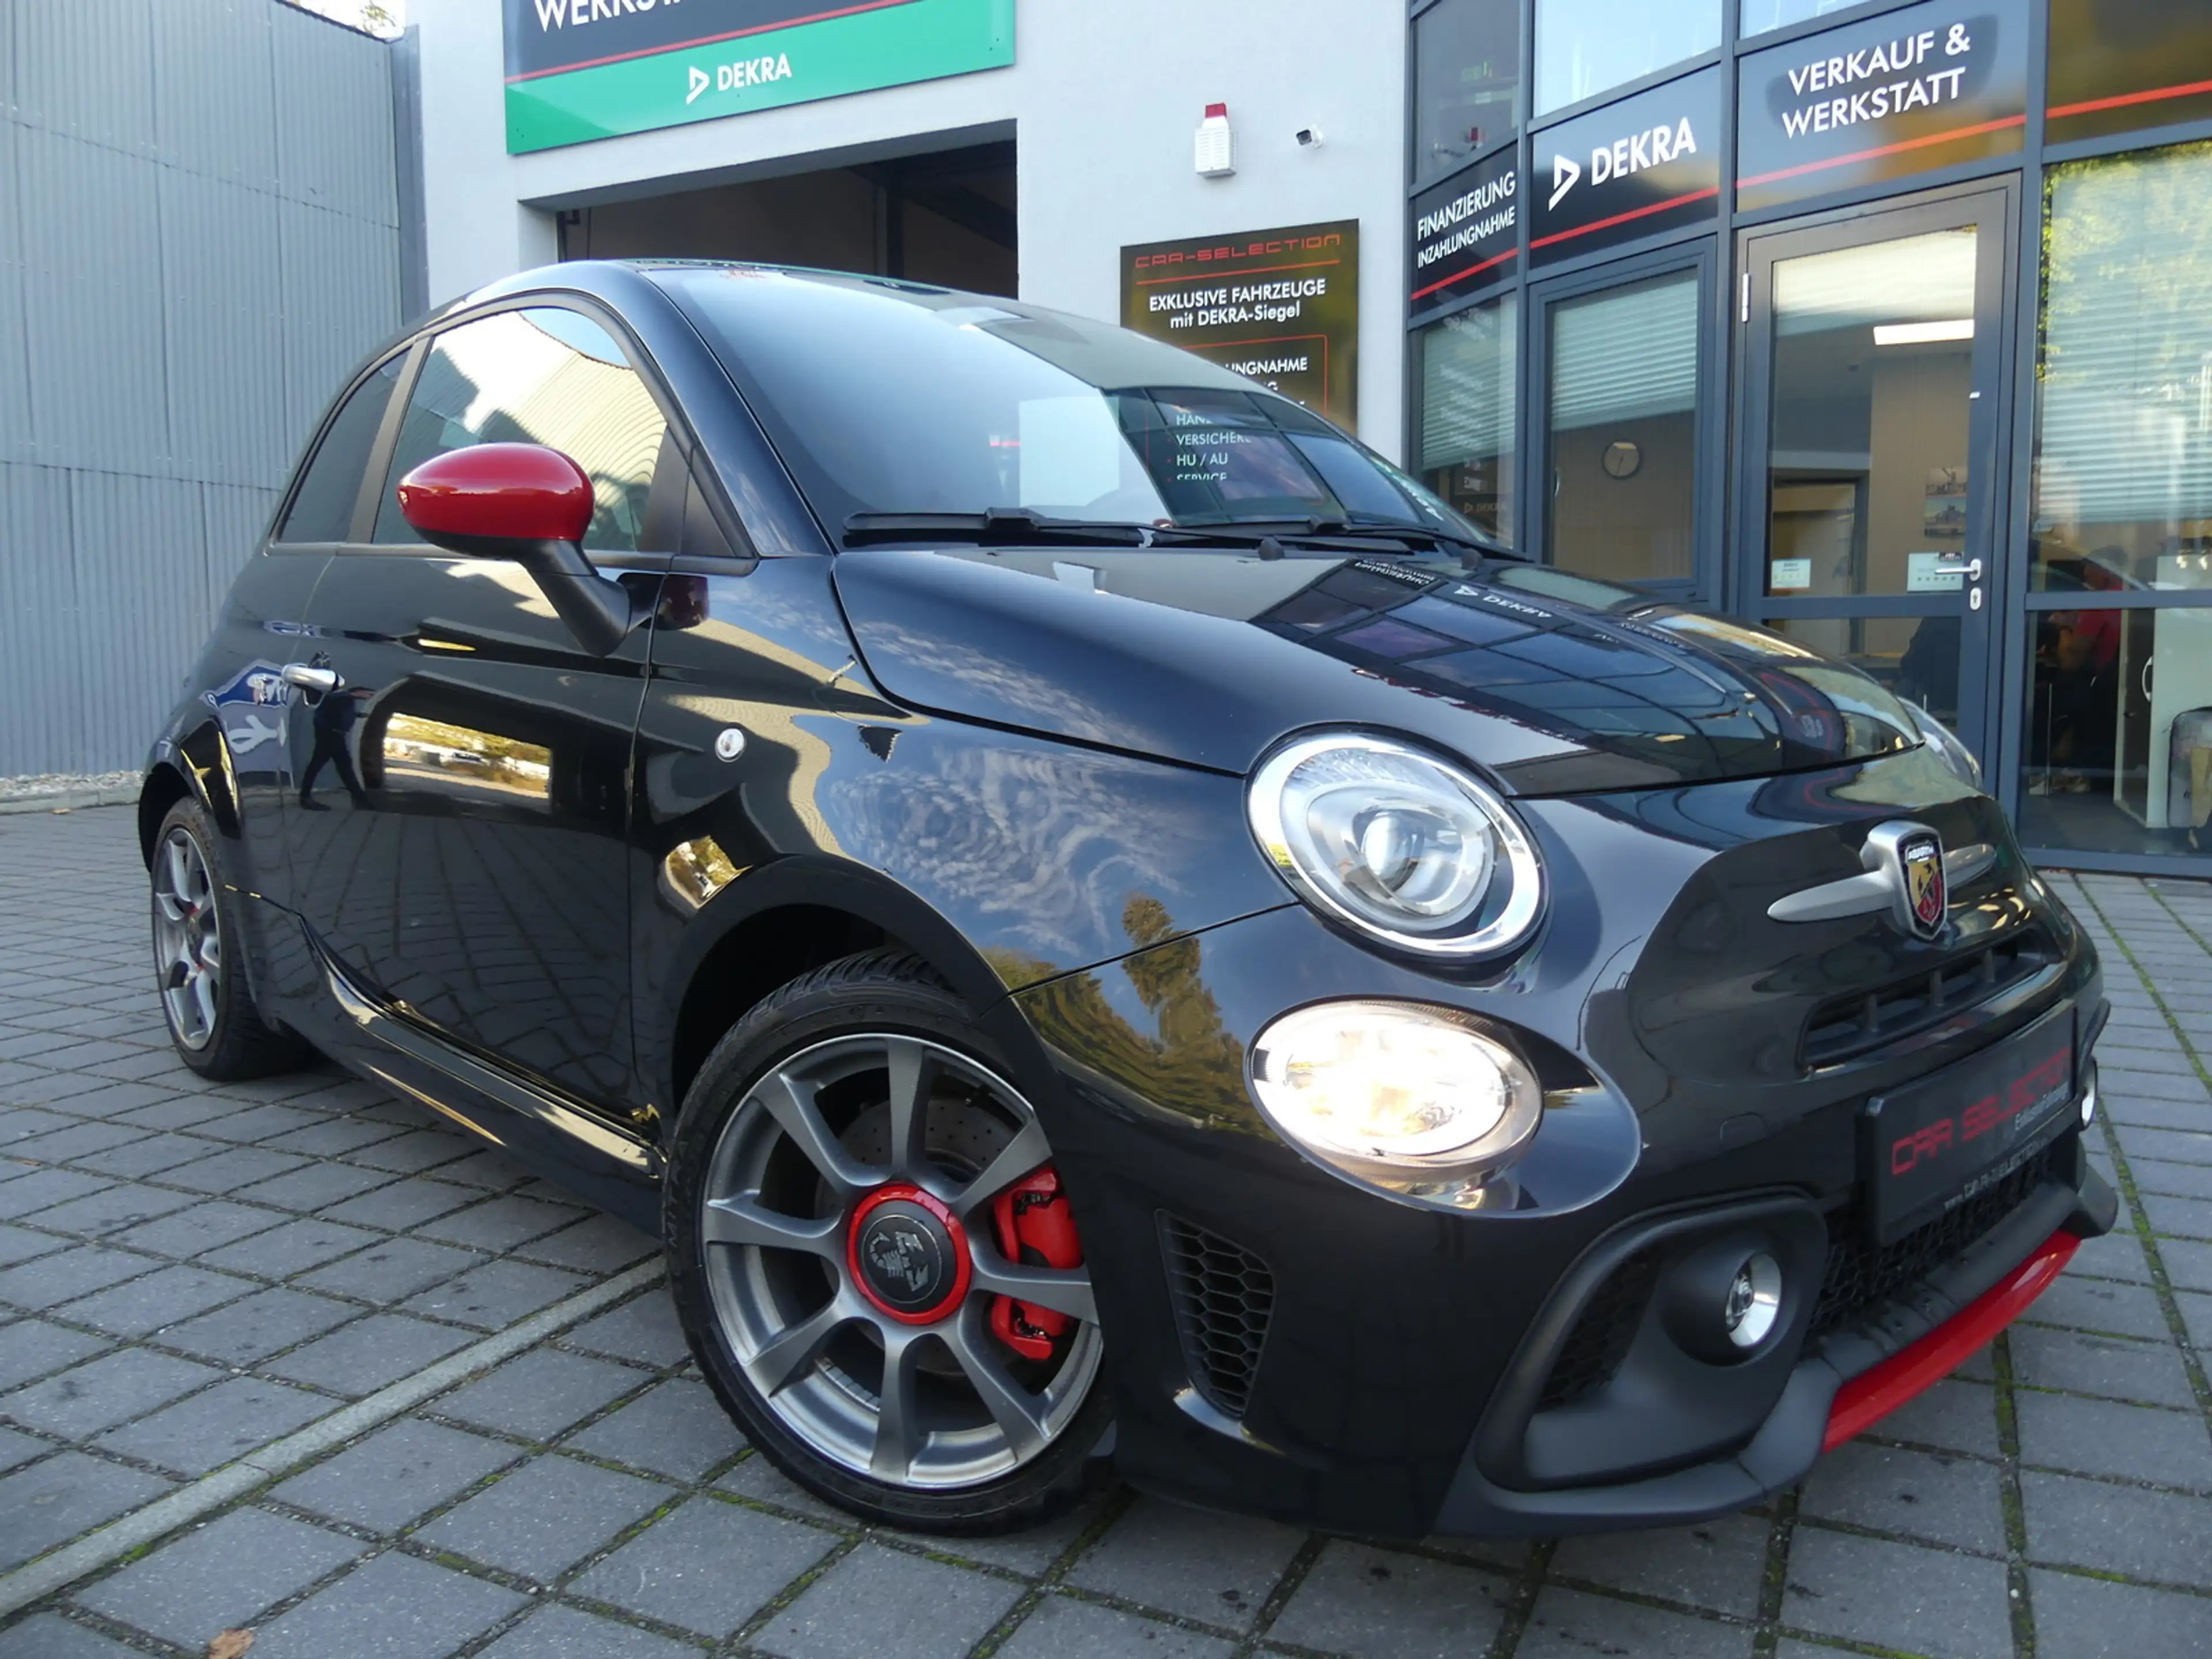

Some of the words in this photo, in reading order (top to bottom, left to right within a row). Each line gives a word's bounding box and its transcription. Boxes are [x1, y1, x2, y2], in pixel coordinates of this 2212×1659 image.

[717, 52, 792, 91] DEKRA
[1788, 31, 1934, 96] VERKAUF
[1945, 23, 1971, 56] &
[1782, 66, 1965, 139] WERKSTATT
[1591, 116, 1697, 186] DEKRA
[1417, 171, 1516, 241] FINANZIERUNG
[1135, 234, 1341, 268] CAR-SELECTION
[1417, 206, 1516, 269] INZAHLUNGNAHME
[1149, 287, 1228, 312] EXKLUSIVE
[1231, 278, 1326, 304] FAHRZEUGE
[1170, 312, 1194, 329] mit
[1198, 301, 1301, 327] DEKRA-Siegel
[1176, 414, 1213, 426] HAN
[1176, 432, 1252, 446] VERSICHER
[1176, 454, 1196, 467] HU
[1200, 453, 1207, 467] /
[1210, 452, 1228, 465] AU
